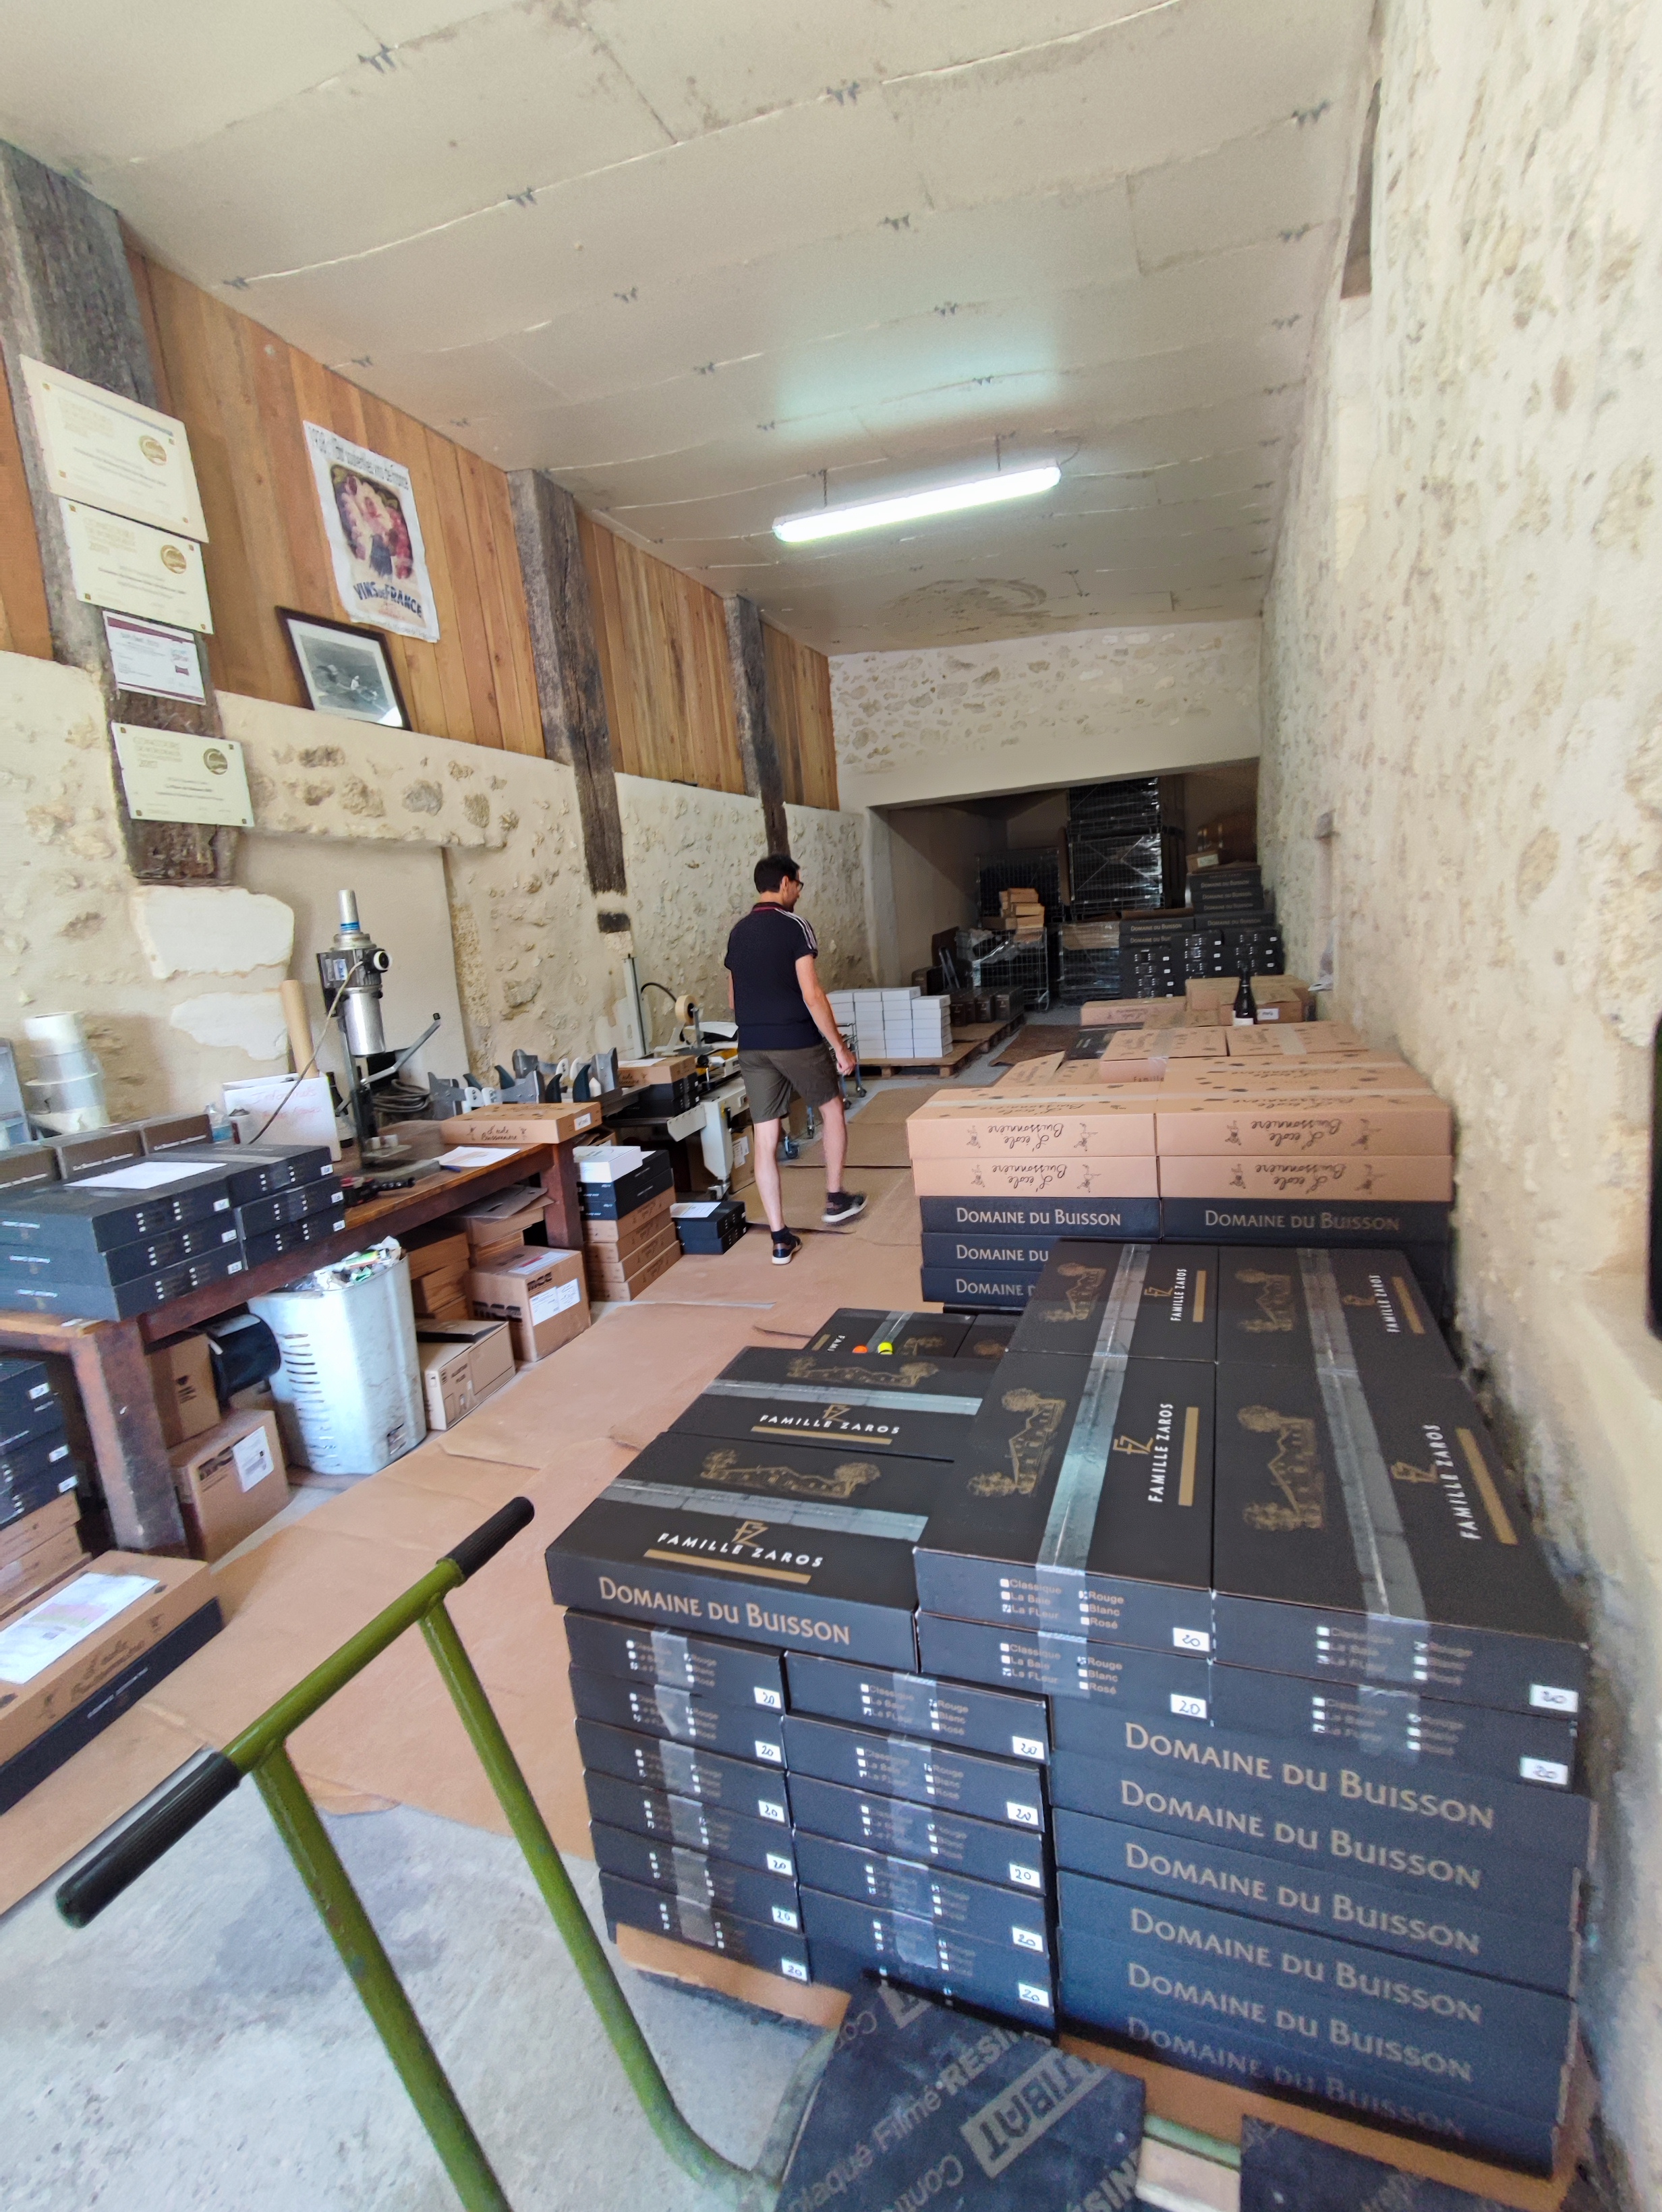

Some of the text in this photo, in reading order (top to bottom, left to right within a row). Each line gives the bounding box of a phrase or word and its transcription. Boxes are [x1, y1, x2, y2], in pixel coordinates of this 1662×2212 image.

[353, 581, 378, 600] VINS
[384, 584, 422, 618] FRANCE
[988, 1123, 1064, 1138] Buissonnière
[992, 1163, 1068, 1179] Buissonnière
[956, 1207, 1121, 1226] DOMAINE DU BUISSON
[1205, 1209, 1400, 1231] DOMAINE DU BUISSON
[956, 1245, 1049, 1262] DOMAINE DU
[956, 1279, 1024, 1296] DOMAINE
[1170, 1269, 1187, 1321] FAMILLE ZAROS
[1368, 1275, 1401, 1333] FAMILLE ZAROS
[760, 1415, 900, 1434] FAMILLE ZAROS
[1148, 1403, 1174, 1503] FAMILLE ZAROS
[1421, 1424, 1482, 1540] FAMILLE ZAROS
[657, 1532, 824, 1568] FAMILLE ZAROS
[1010, 1578, 1061, 1595] Classique
[1010, 1590, 1024, 1600] La
[1089, 1590, 1124, 1606] Rouge
[598, 1576, 851, 1646] DOMAINE DU BUISSON
[1011, 1603, 1025, 1614] La
[1089, 1604, 1120, 1617] Blanc
[1089, 1617, 1118, 1629] Rosé
[1182, 1634, 1201, 1648] 20
[1010, 1643, 1061, 1660] Classique
[1010, 1655, 1024, 1665] La
[1087, 1656, 1122, 1670] Rouge
[1011, 1668, 1025, 1678] La
[1088, 1669, 1118, 1682] Blanc
[1089, 1682, 1116, 1695] Rosé
[762, 1691, 775, 1706] 20
[1179, 1700, 1201, 1715] 20
[761, 1745, 774, 1757] 20
[1021, 1743, 1037, 1755] 20
[1125, 1721, 1495, 1830] DOMAINE DU BUISSON
[764, 1806, 778, 1816] 20
[1016, 1808, 1032, 1822] 20
[1120, 1780, 1483, 1890] DOMAINE DU BUISSON
[773, 1859, 786, 1870] 20
[1015, 1868, 1032, 1881] 20
[1125, 1842, 1481, 1956] DOMAINE DU BUISSON
[777, 1909, 791, 1921] 20
[1018, 1933, 1036, 1948] 20
[787, 1964, 803, 1977] 20
[1130, 1907, 1483, 2024] DOMAINE DU BUISSON
[1022, 1988, 1040, 2003] 20
[1127, 1962, 1473, 2084] DOMAINE DU BUISSON
[1127, 2016, 1261, 2076] DOMAINE
[1273, 2065, 1316, 2093] DU
[872, 2083, 942, 2152] Filmé
